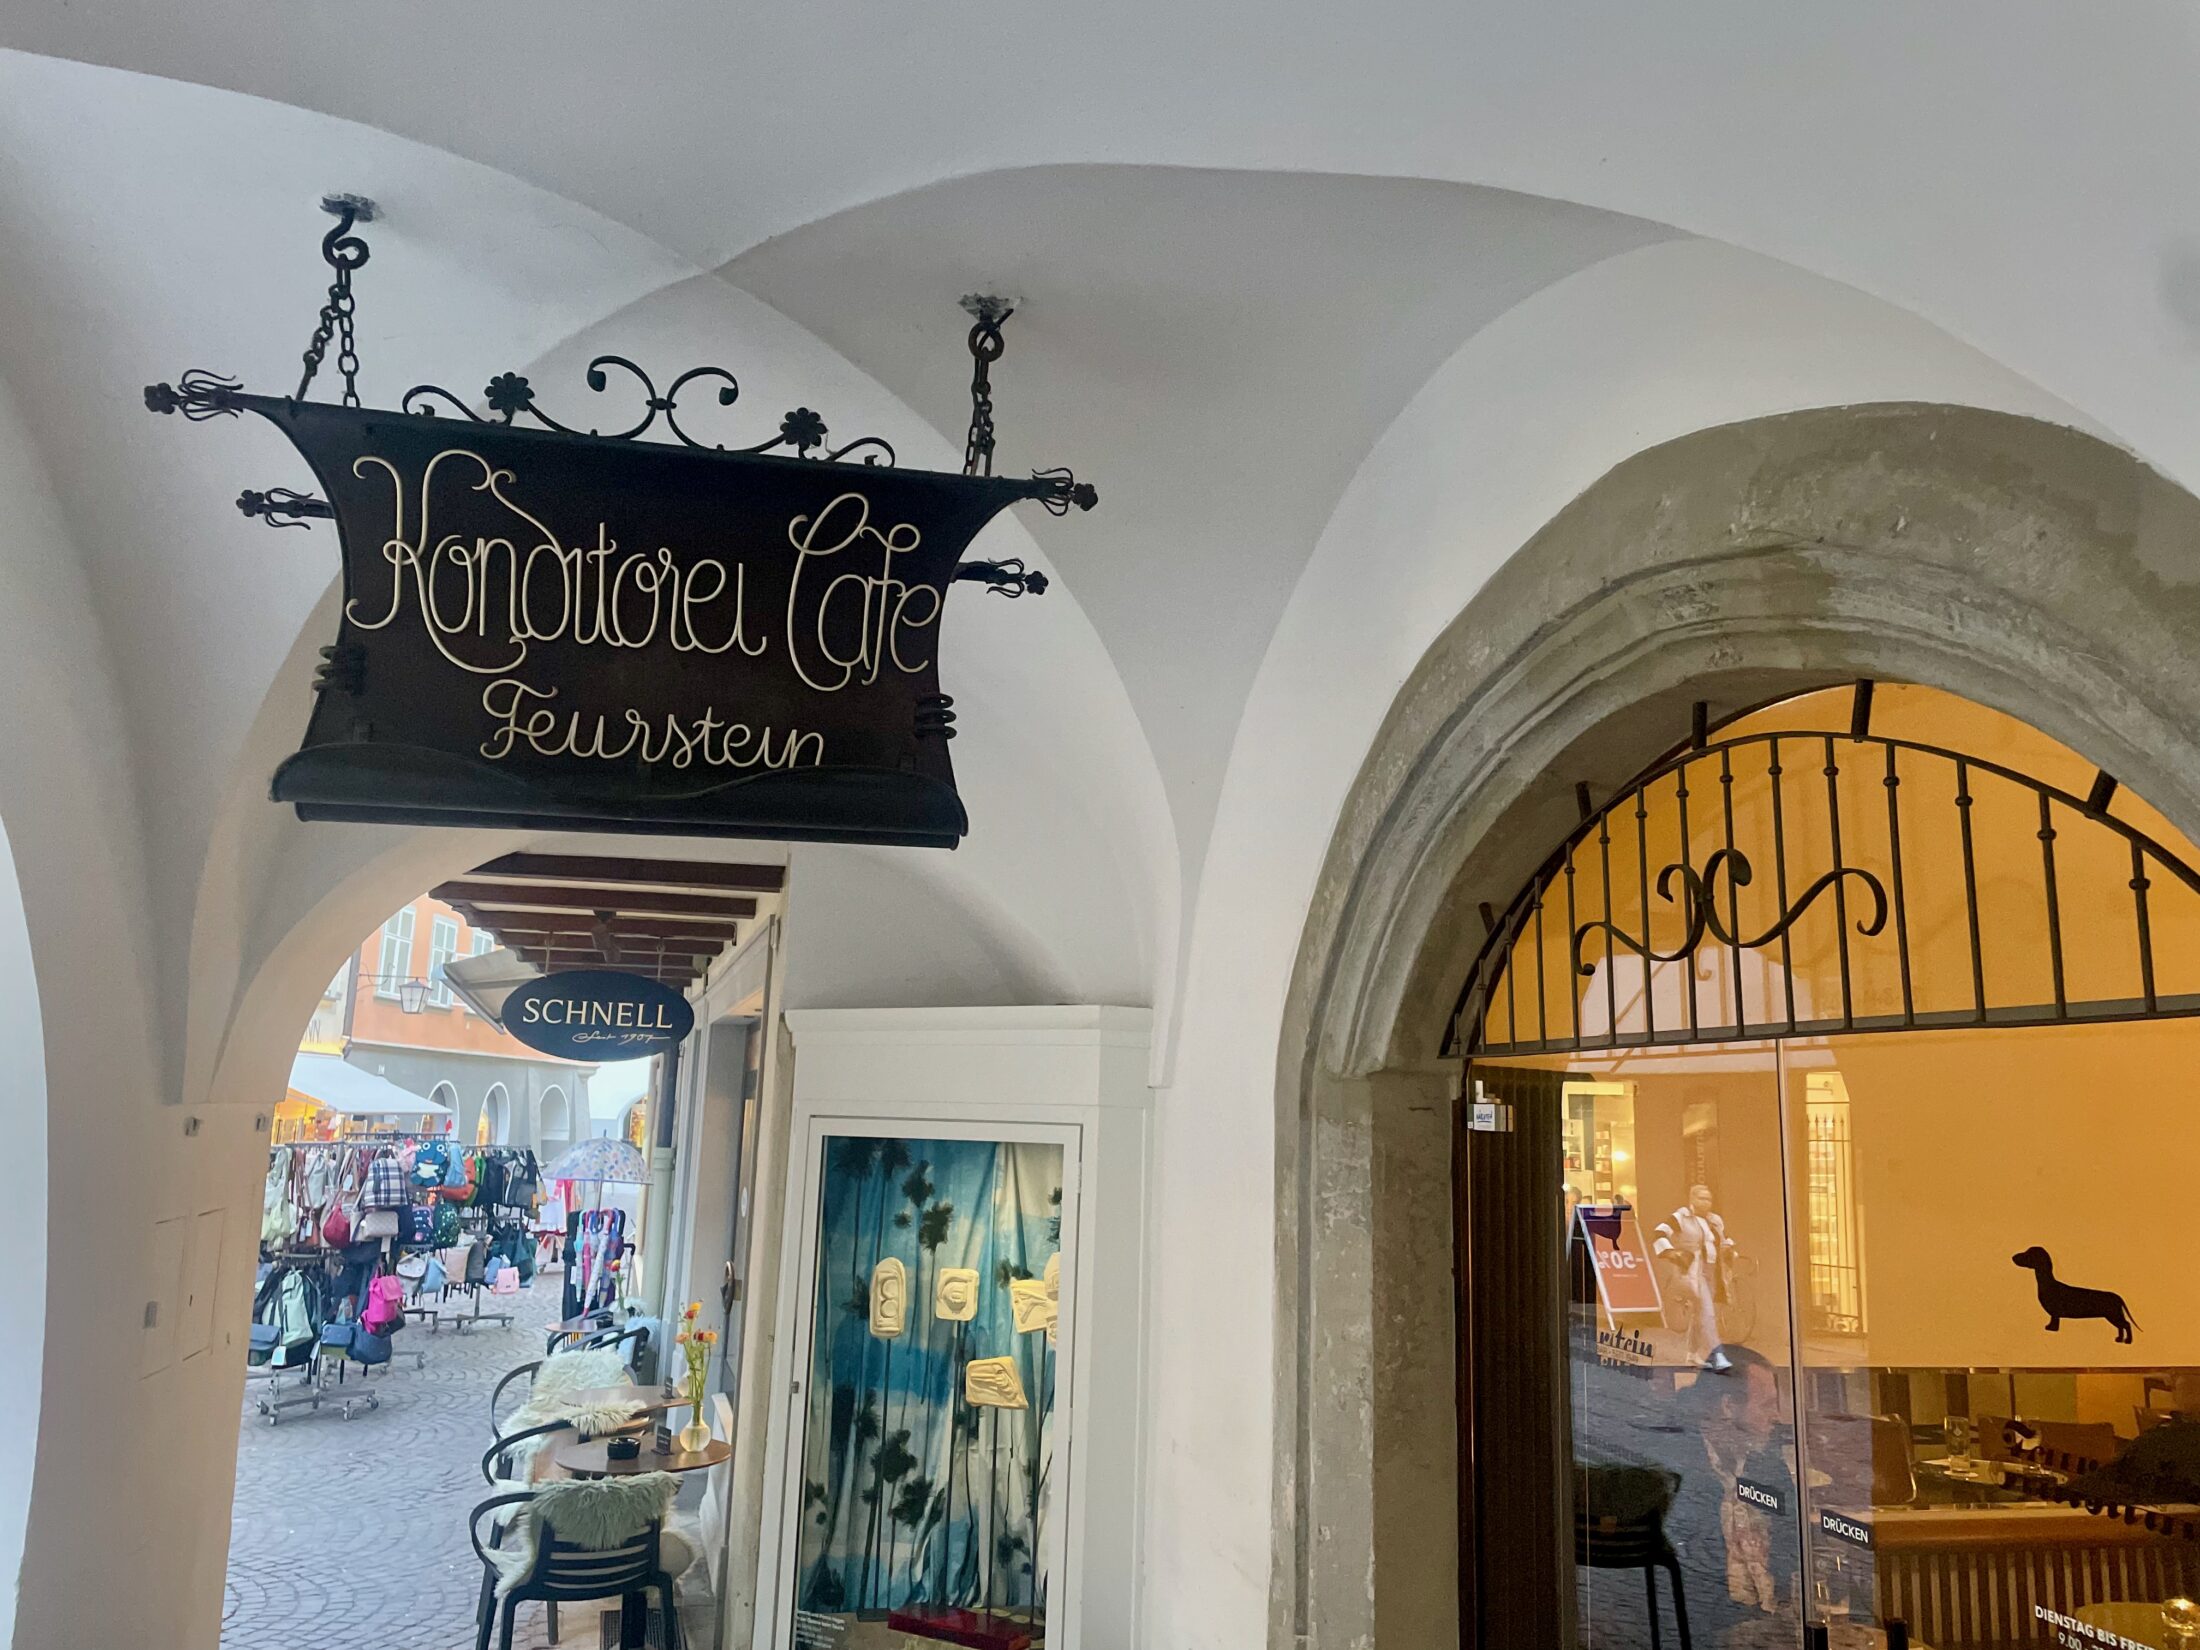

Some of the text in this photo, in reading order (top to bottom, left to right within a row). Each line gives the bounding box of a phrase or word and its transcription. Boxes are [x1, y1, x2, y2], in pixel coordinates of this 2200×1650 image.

[346, 449, 767, 673] Konditorei
[480, 678, 825, 770] Feurstein
[522, 998, 673, 1029] SCHNELL
[1738, 1484, 1778, 1510] DRÜCKEN
[1823, 1516, 1869, 1543] DRÜCKEN
[2034, 1605, 2095, 1638] DIENSTAG
[2097, 1629, 2118, 1647] BIS
